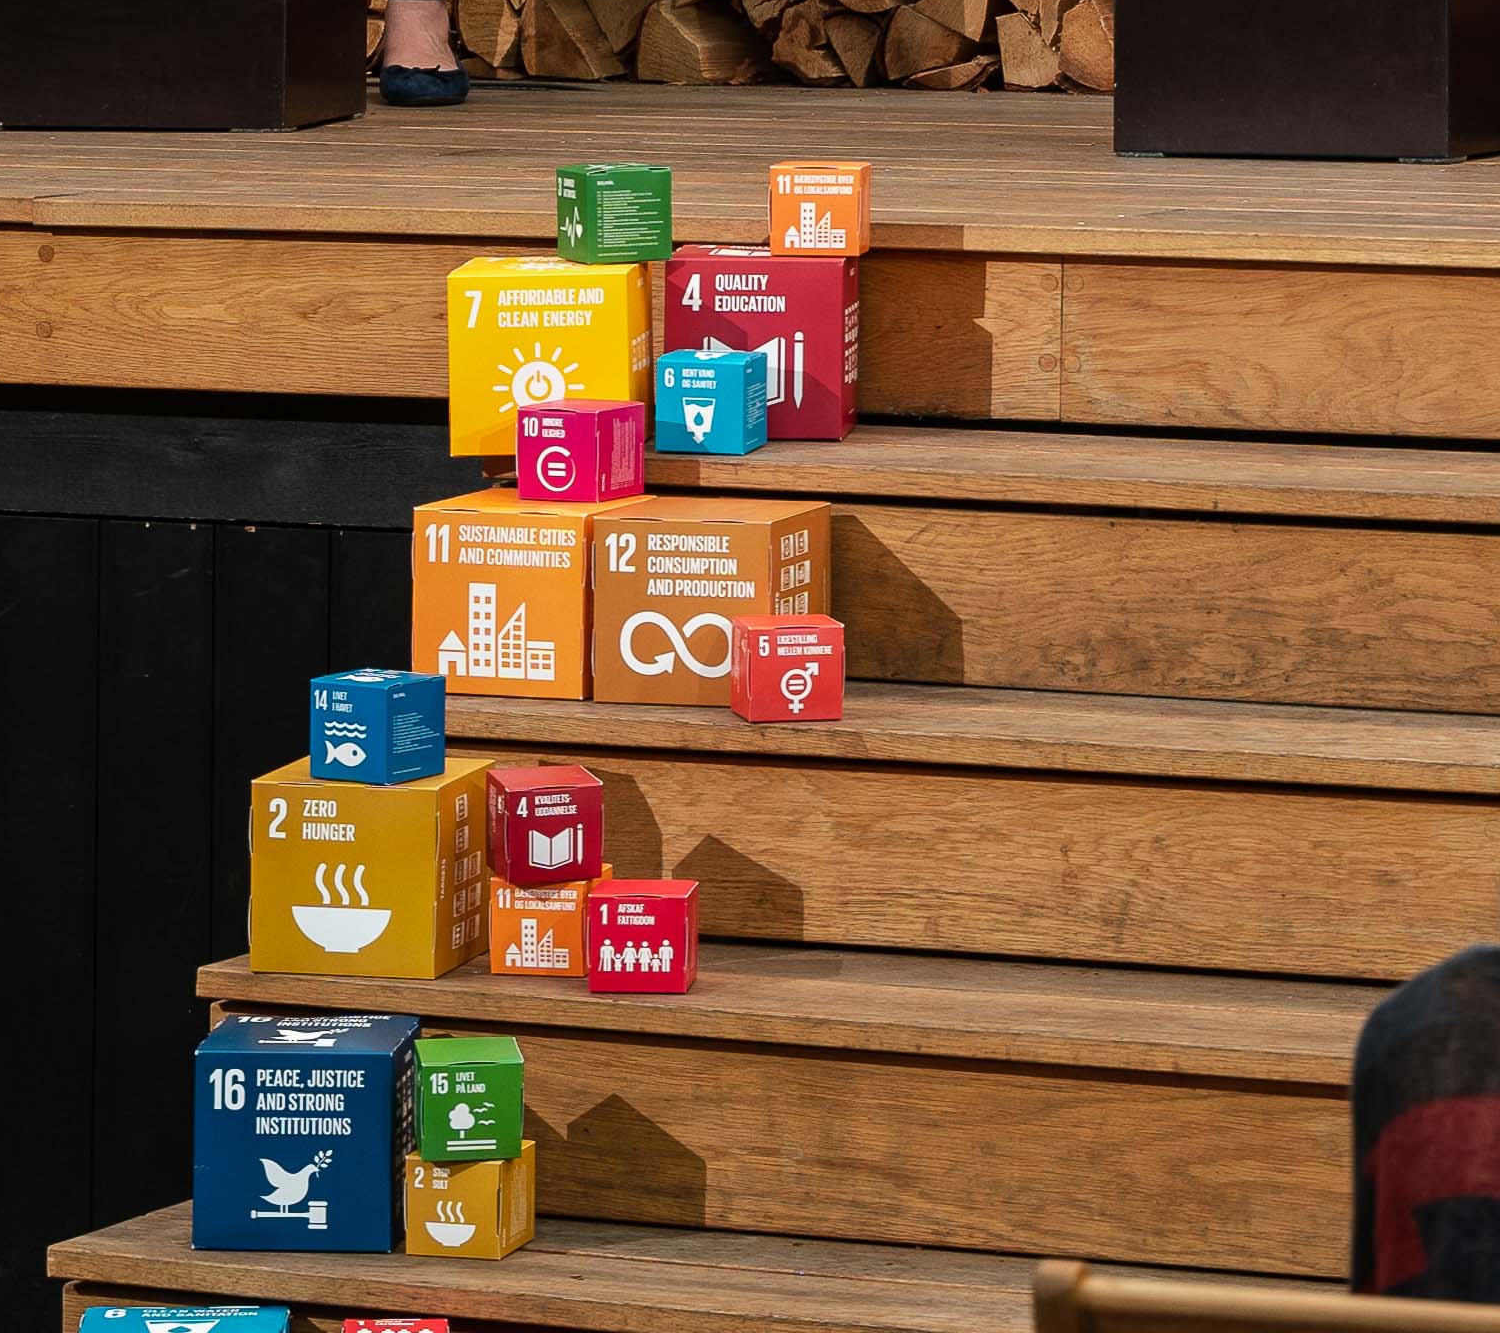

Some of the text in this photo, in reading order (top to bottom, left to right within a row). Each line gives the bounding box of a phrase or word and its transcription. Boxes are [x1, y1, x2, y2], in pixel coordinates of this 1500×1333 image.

[776, 174, 791, 194] 11
[681, 273, 702, 312] 4
[714, 274, 769, 292] QUALITY
[497, 288, 605, 307] AFFORDABLE AND
[714, 295, 786, 313] EDUCATION
[464, 290, 482, 329] 7
[497, 309, 593, 329] CLEAN ENERGY
[664, 367, 675, 388] 6
[522, 416, 539, 438] 10
[425, 523, 450, 564] 11
[458, 525, 577, 547] SUSTAINABLE CITIES
[647, 533, 730, 554] RESPONSIBLE
[458, 548, 571, 569] AND COMMUNITIES
[604, 532, 637, 573] 12
[647, 556, 738, 576] CONSUMPTION
[647, 579, 756, 599] AND PRODUCTION
[758, 635, 770, 657] 5
[314, 689, 328, 711] 14
[302, 799, 337, 819] ZERO
[516, 796, 529, 818] 4
[267, 797, 288, 840] 2
[301, 822, 356, 843] HUNGER
[496, 888, 511, 910] 11
[599, 903, 609, 926] 1
[208, 1068, 246, 1112] 16
[256, 1069, 366, 1090] PEACE, JUSTICE
[429, 1072, 449, 1094] 15
[256, 1092, 345, 1112] AND STRONG
[255, 1116, 352, 1136] INSTITUTIONS
[414, 1166, 425, 1188] 2
[104, 1309, 127, 1319] 6
